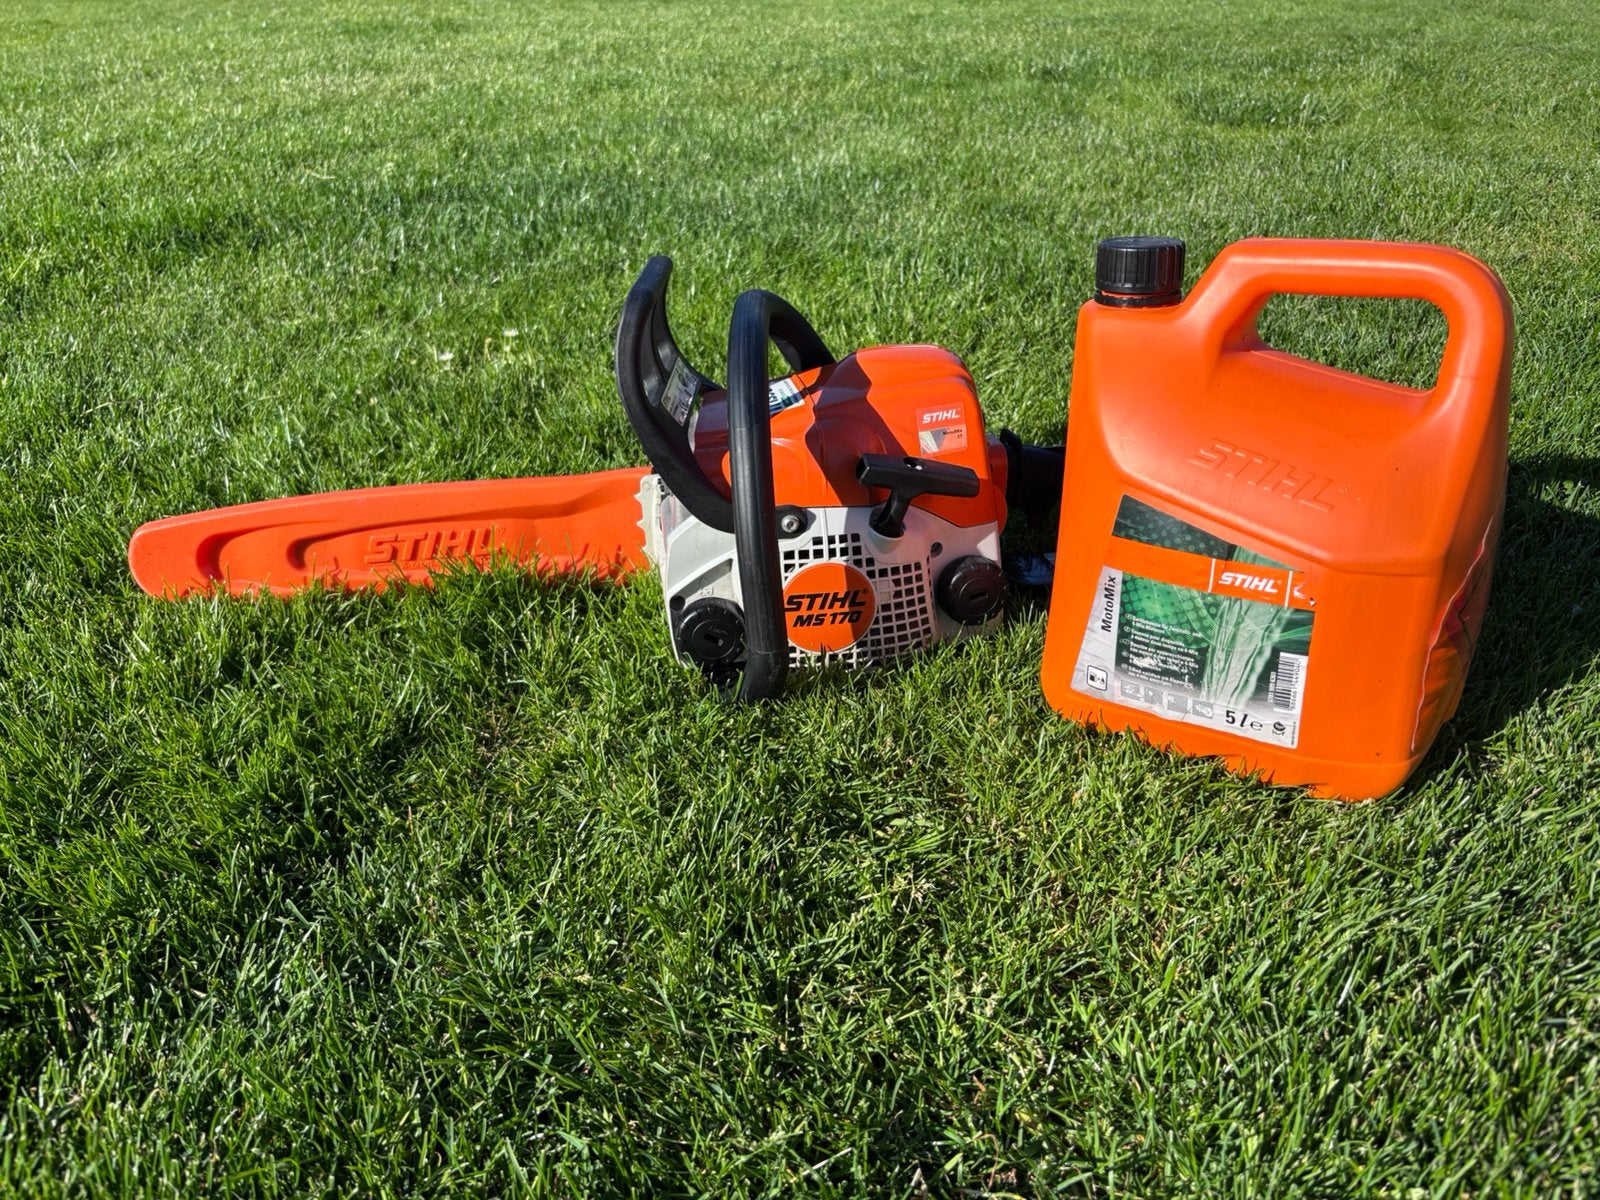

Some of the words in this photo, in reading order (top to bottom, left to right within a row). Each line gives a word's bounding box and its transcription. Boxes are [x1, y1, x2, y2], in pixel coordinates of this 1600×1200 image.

[922, 408, 960, 424] STIHL
[1187, 438, 1335, 512] STIHL
[364, 527, 502, 564] STIHL
[1218, 571, 1279, 594] STIHL
[784, 589, 867, 612] STIHL
[1101, 575, 1117, 633] MotoMix
[792, 613, 827, 628] MS
[830, 610, 863, 625] 170
[1225, 709, 1236, 725] 5
